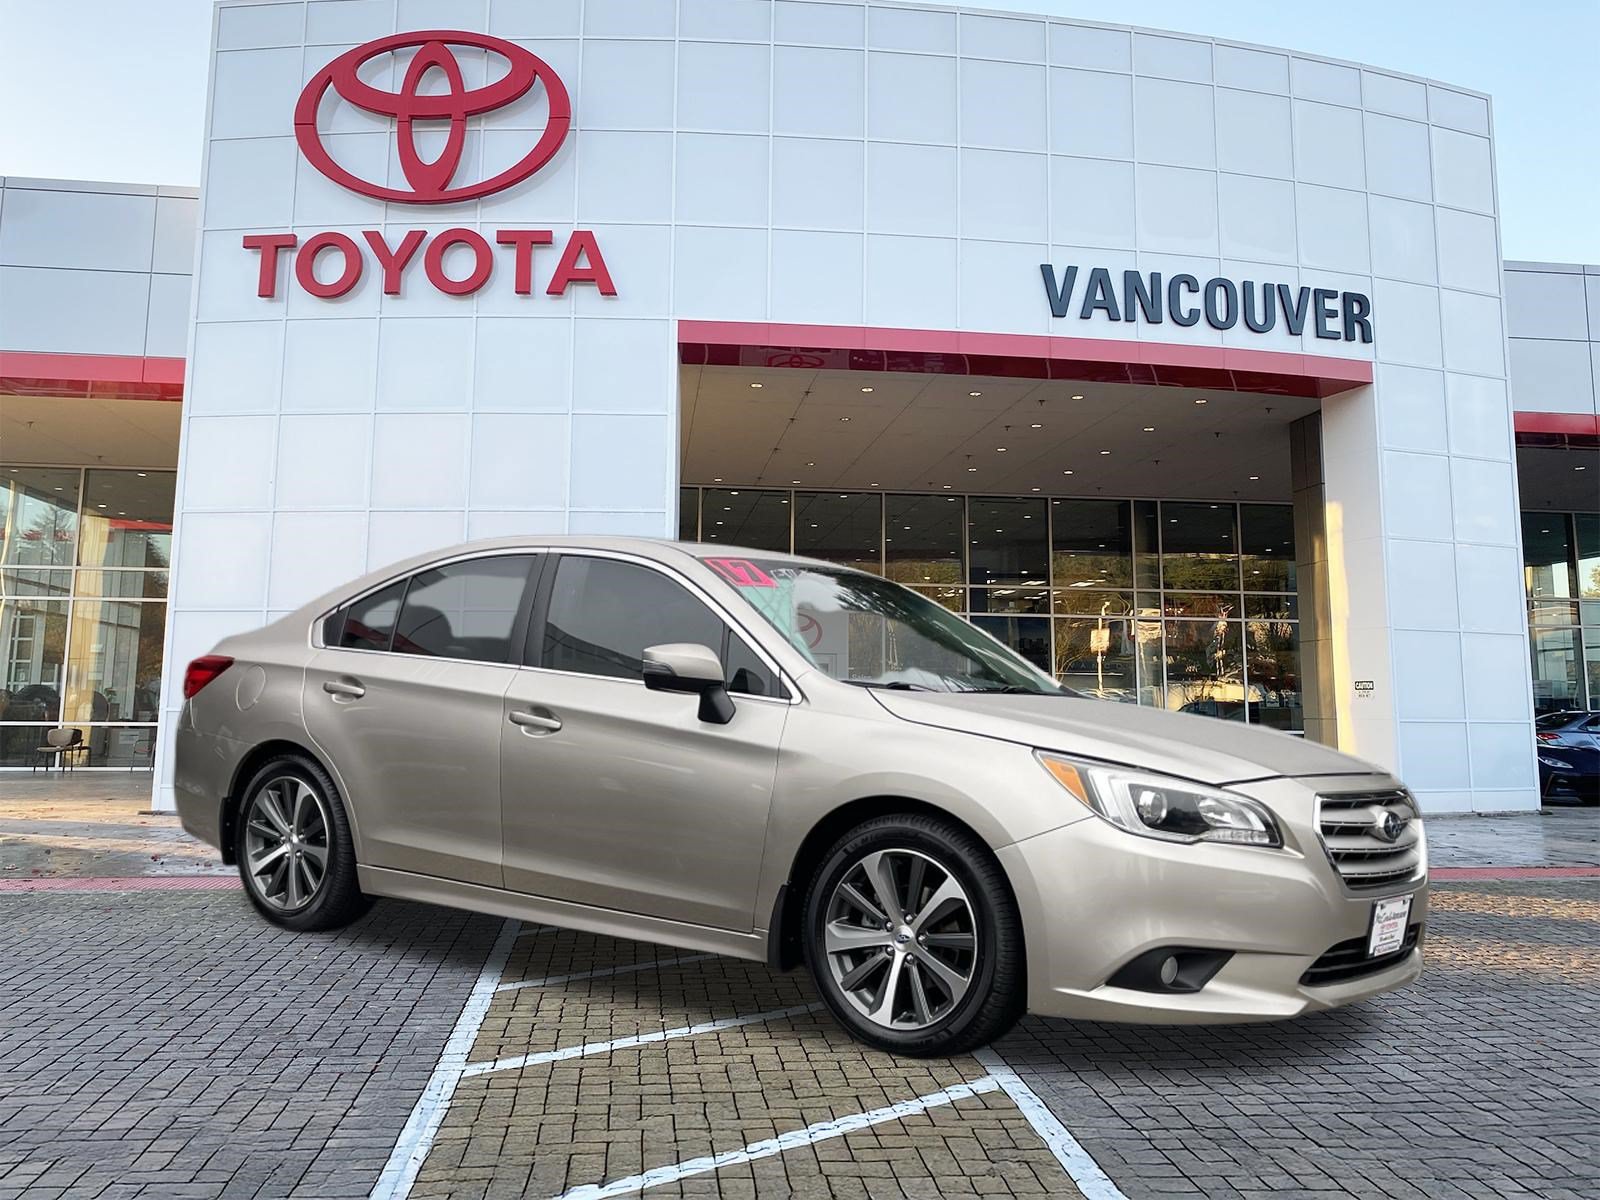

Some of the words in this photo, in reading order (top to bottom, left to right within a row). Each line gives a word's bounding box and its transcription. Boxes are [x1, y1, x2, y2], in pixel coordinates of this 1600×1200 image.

[243, 228, 618, 299] TOYOTA
[1040, 264, 1373, 343] VANCOUVER
[709, 560, 762, 582] 17
